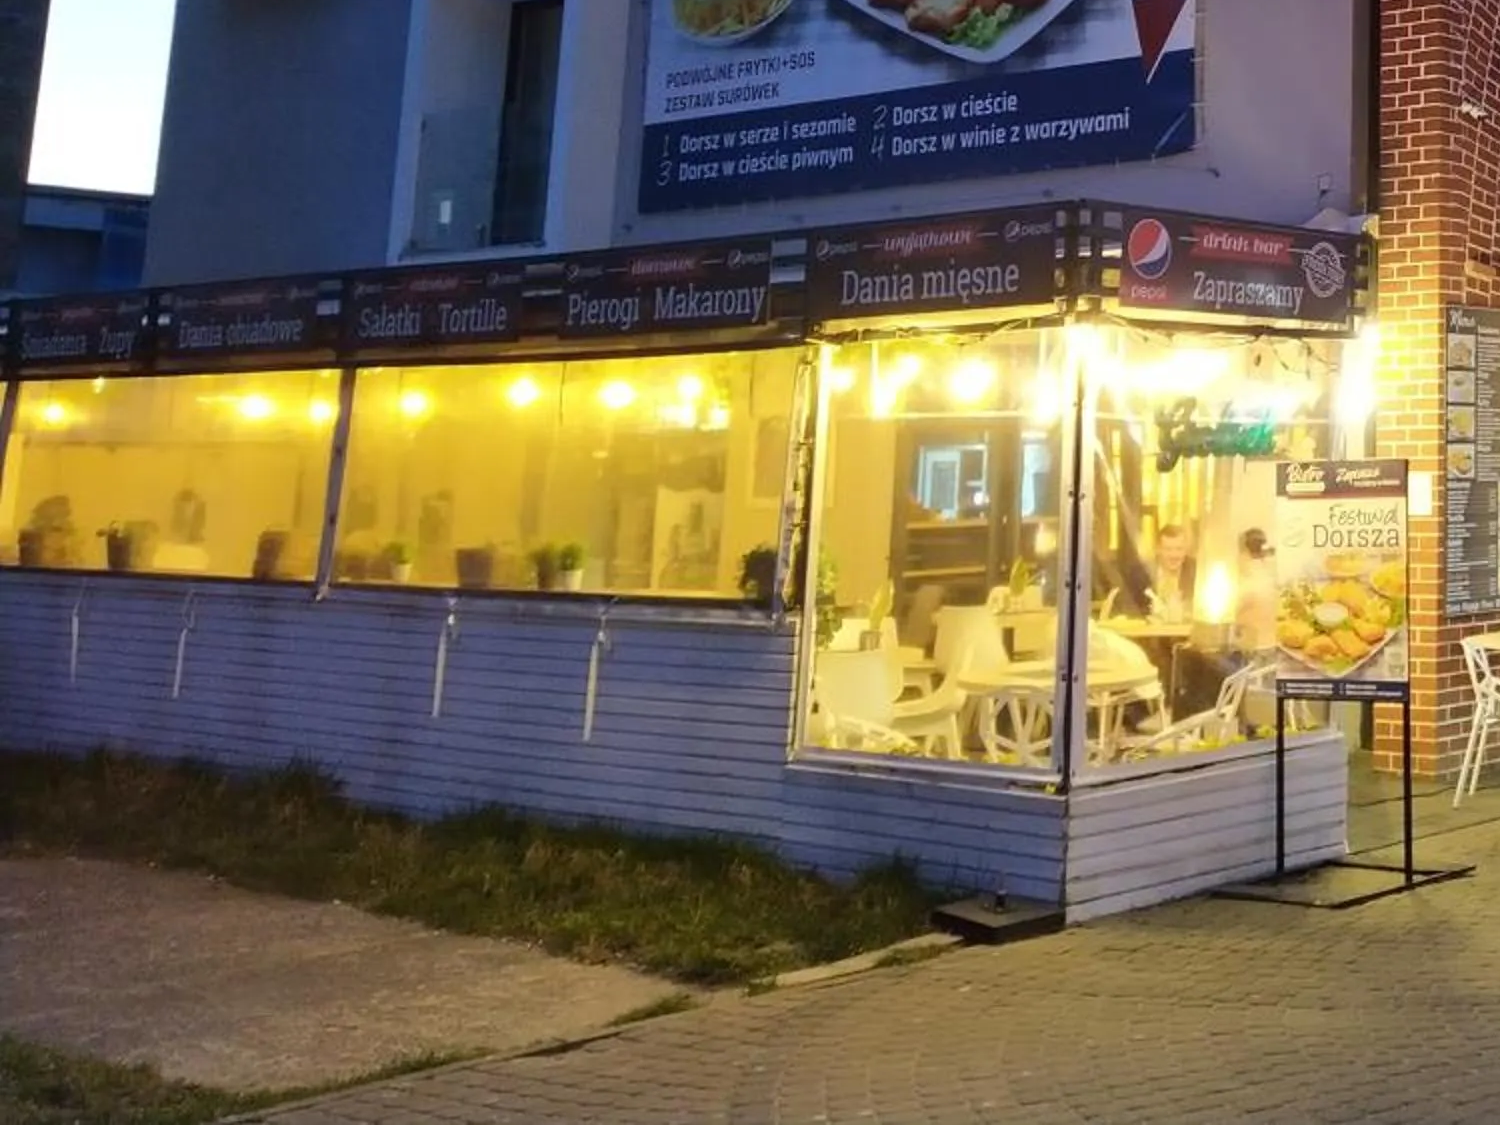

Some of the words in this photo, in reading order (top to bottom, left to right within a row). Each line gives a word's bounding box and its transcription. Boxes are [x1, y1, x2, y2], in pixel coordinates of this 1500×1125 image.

[664, 90, 717, 115] ZESTAW
[892, 104, 938, 127] Dorsz
[941, 102, 958, 120] w
[960, 90, 1019, 119] cieście
[679, 133, 720, 155] Dorsz
[722, 132, 737, 149] w
[739, 125, 780, 148] serze
[890, 134, 938, 157] Dorsz
[941, 133, 956, 151] w
[960, 122, 1006, 149] winie
[1010, 126, 1021, 144] z
[1024, 105, 1131, 140] warzywami
[678, 160, 720, 183] Dorsz
[721, 158, 736, 176] w
[738, 148, 790, 176] cieście
[791, 144, 854, 173] piwnym
[1202, 230, 1249, 253] drink
[1252, 238, 1285, 257] bar
[840, 264, 914, 306] Dania
[921, 256, 1020, 305] mięsne
[1192, 271, 1305, 316] Zapraszamy
[437, 298, 508, 335] Tortille
[564, 286, 642, 332] Pierogi
[653, 282, 767, 323] Makarony
[1328, 502, 1400, 528] Festiwal
[1312, 524, 1400, 549] Dorsza
